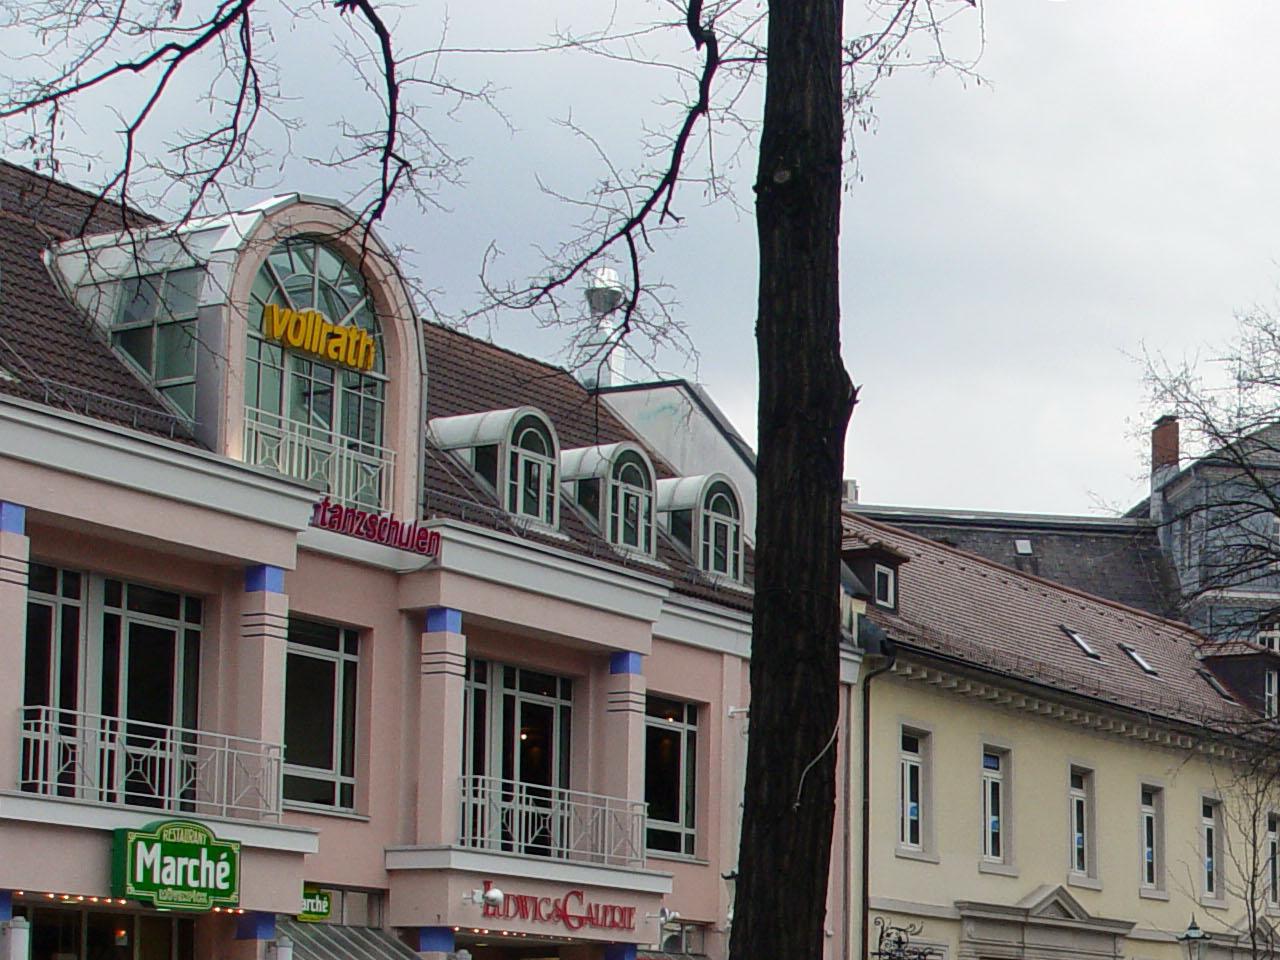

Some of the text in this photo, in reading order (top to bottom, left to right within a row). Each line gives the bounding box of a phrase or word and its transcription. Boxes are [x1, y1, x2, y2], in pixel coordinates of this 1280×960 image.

[266, 304, 376, 370] vollrath
[162, 827, 207, 845] RESTAURANT
[136, 840, 231, 889] Marché
[301, 893, 329, 913] arché
